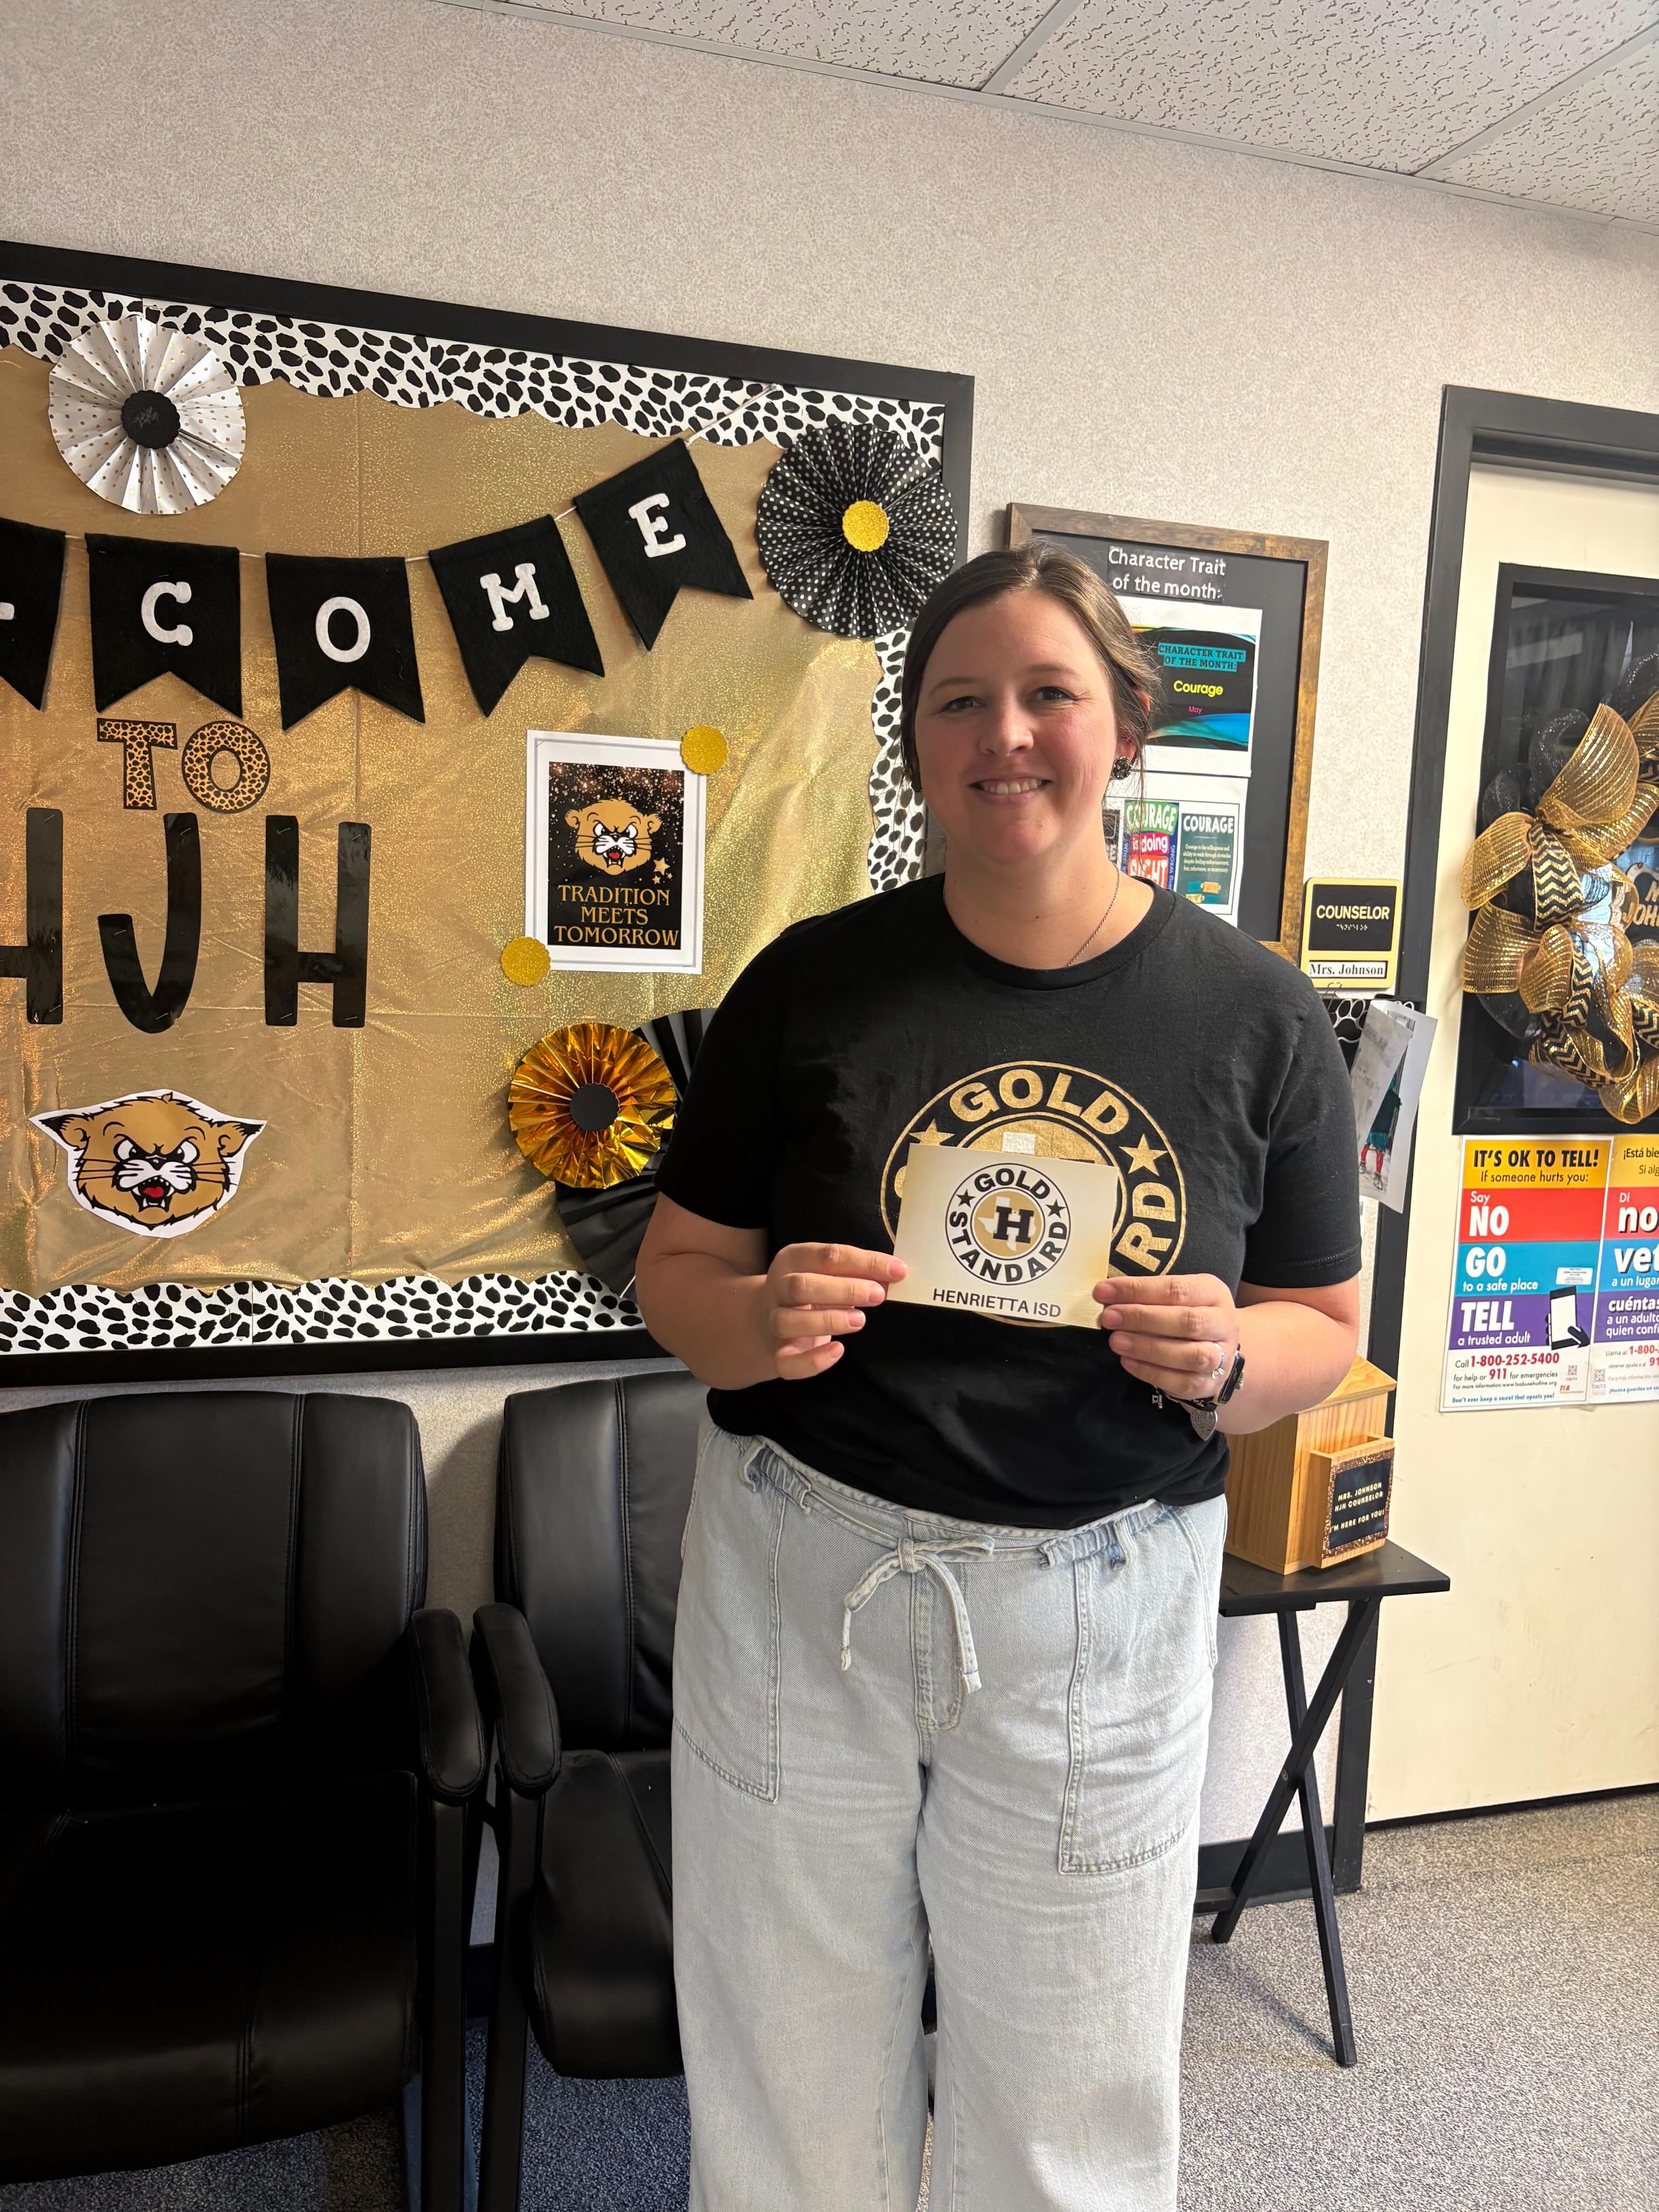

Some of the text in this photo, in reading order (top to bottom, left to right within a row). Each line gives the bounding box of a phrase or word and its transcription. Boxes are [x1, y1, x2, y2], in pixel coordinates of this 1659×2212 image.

[1109, 548, 1226, 576] Character Trait
[0, 492, 686, 663] COME
[1112, 574, 1223, 599] of the month:
[1158, 645, 1243, 660] CHARACTER TRAIT
[1164, 656, 1237, 670] OF THE MONTH:
[1174, 680, 1223, 697] Courage
[1188, 706, 1202, 714] May
[97, 718, 271, 814] TO
[1183, 815, 1234, 834] COURAGE
[1141, 834, 1168, 854] doing
[557, 884, 670, 906] TRADITION
[581, 906, 649, 926] MEETS
[1316, 905, 1390, 920] COUNSELOR
[1622, 902, 1659, 927] JOH
[554, 926, 679, 947] TOMORROW
[1310, 963, 1384, 975] Mrs. Johnson
[949, 1068, 1130, 1135] GOLD
[1473, 1149, 1599, 1167] IT'S OK TO TELL!
[1623, 1147, 1644, 1160] ¡Está
[1481, 1170, 1588, 1185] If someone hurts you:
[1638, 1164, 1647, 1174] Si
[974, 1168, 1051, 1199] GOLD
[1470, 1190, 1491, 1205] Say
[1619, 1192, 1630, 1203] Di
[993, 1205, 1035, 1244] H
[1469, 1205, 1509, 1237] NO
[1618, 1206, 1659, 1233] no
[949, 1211, 1068, 1283] STANDARD
[1465, 1246, 1506, 1278] GO
[1463, 1277, 1538, 1294] to a safe place
[1611, 1278, 1618, 1287] a
[1621, 1277, 1634, 1286] un
[933, 1288, 1062, 1318] HENRIETTA ISD
[1461, 1300, 1514, 1332] TELL
[1607, 1316, 1613, 1325] a
[1615, 1315, 1628, 1324] un
[1458, 1331, 1530, 1346] a trusted adult
[1606, 1325, 1634, 1339] quien
[1629, 1345, 1659, 1355] 1-800-
[1455, 1352, 1560, 1368] Call 1-800-252-5400
[1465, 1373, 1478, 1382] help
[1489, 1368, 1507, 1380] 911
[1520, 1371, 1558, 1380] emergencies
[1338, 1481, 1382, 1501] MRS. JOHNSON
[1348, 1491, 1384, 1508] COUNSELOR
[1340, 1519, 1356, 1529] HERE
[1358, 1514, 1370, 1523] FOR
